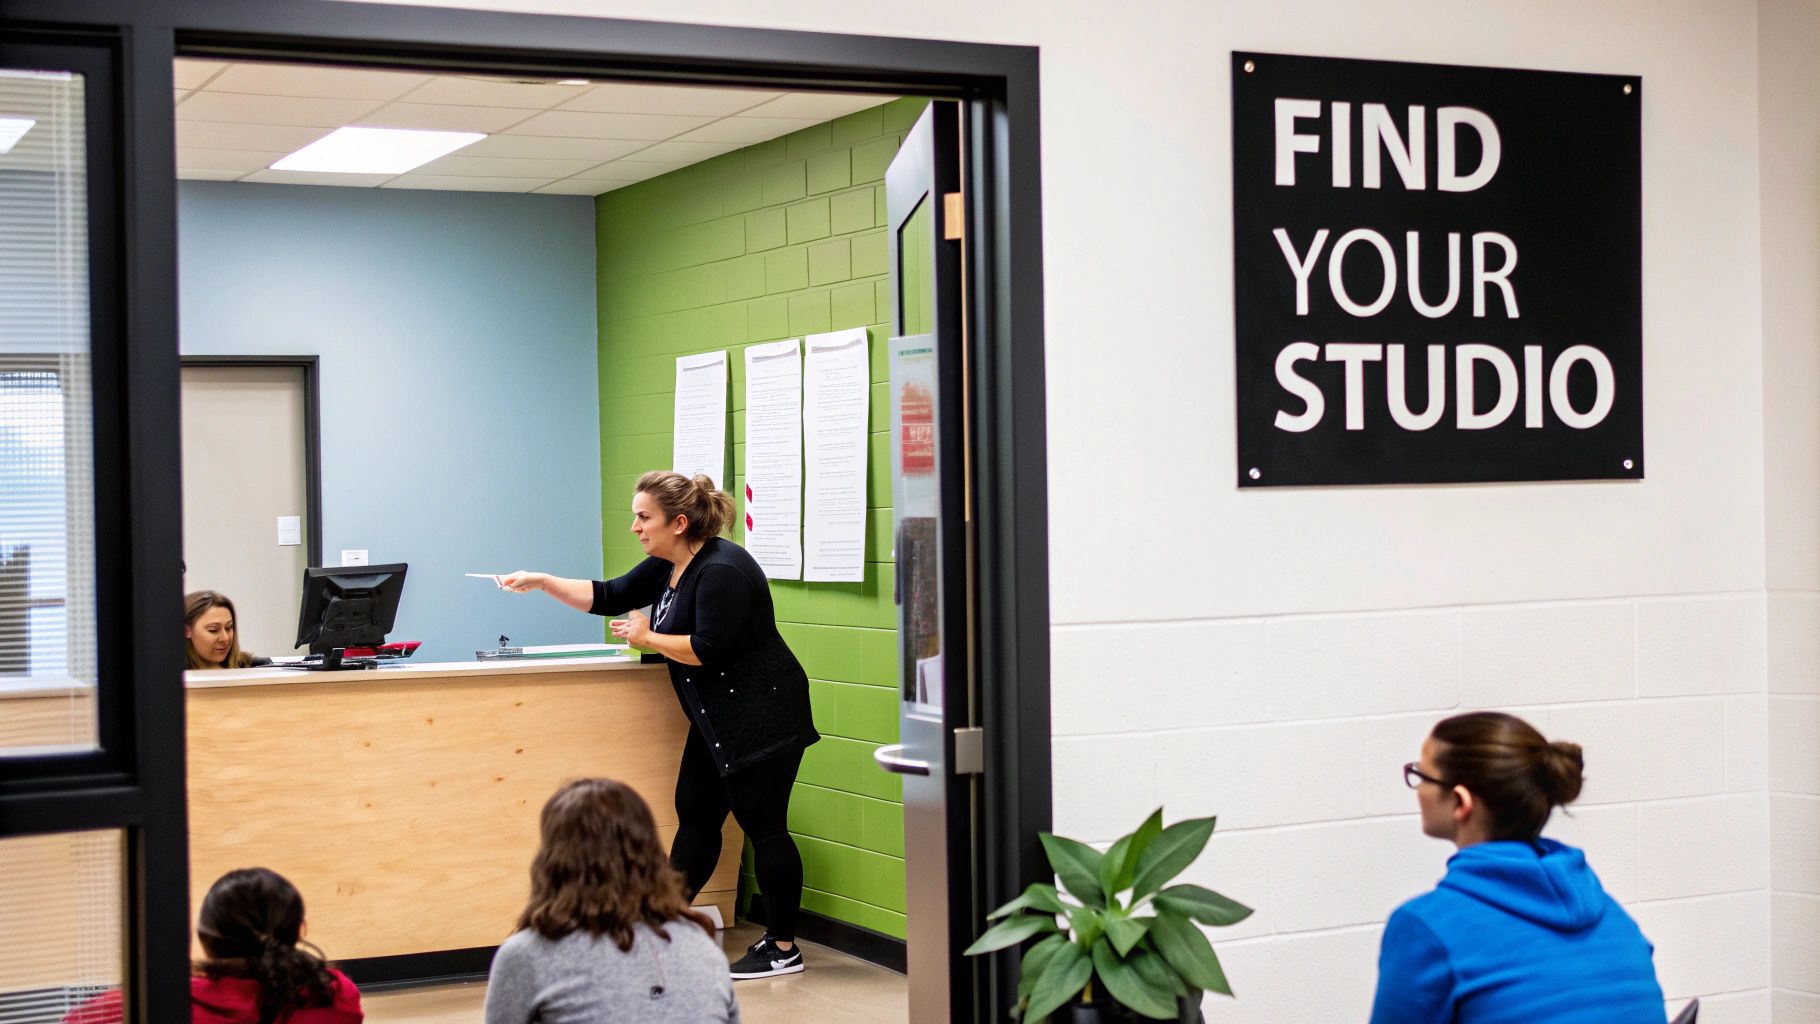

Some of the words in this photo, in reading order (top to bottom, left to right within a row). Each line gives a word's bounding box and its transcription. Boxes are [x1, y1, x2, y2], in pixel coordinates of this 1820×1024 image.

[1274, 97, 1502, 192] FIND
[1273, 227, 1520, 319] YOUR
[1273, 341, 1616, 433] STUDIO
